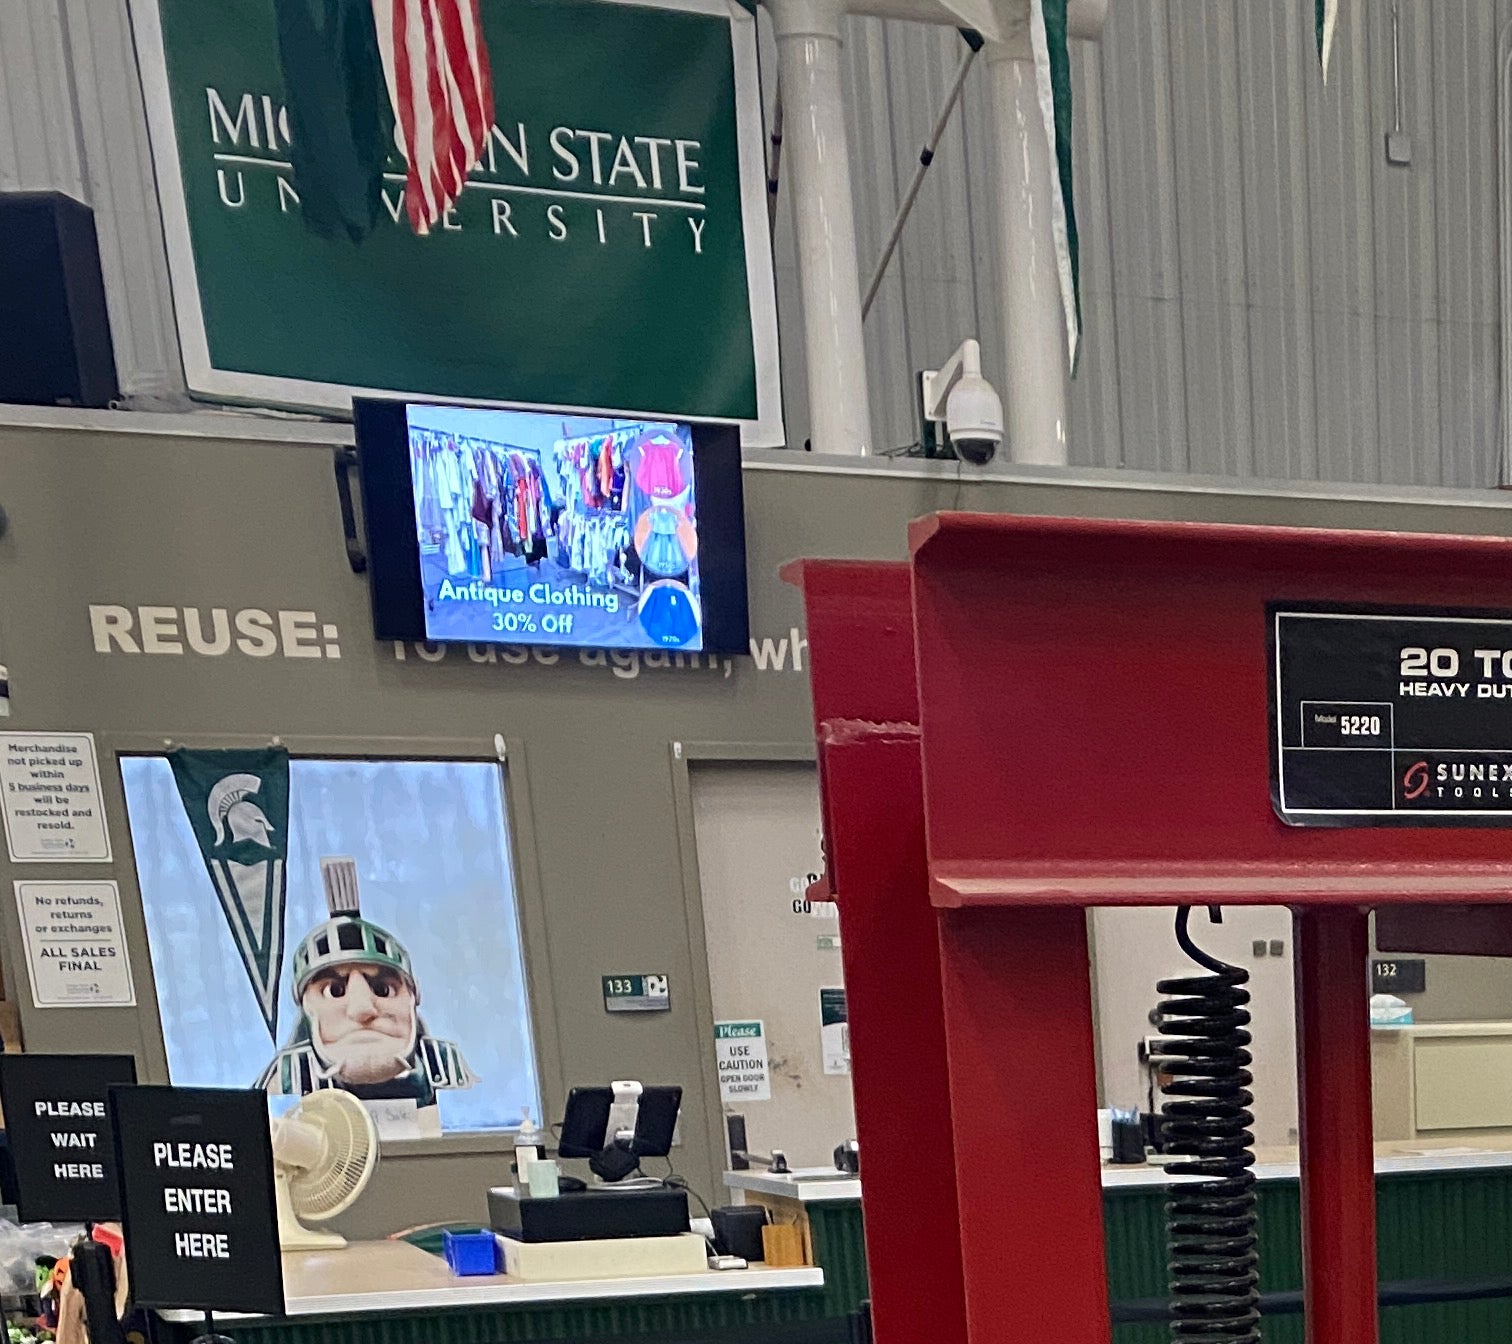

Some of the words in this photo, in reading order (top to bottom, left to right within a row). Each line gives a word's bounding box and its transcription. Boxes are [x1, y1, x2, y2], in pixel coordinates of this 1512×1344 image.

[550, 126, 705, 193] STATE
[217, 169, 705, 254] UNVERSITY
[439, 579, 524, 607] Antique
[529, 583, 619, 612] Clothing
[492, 612, 537, 632] 30%
[542, 613, 574, 634] Off
[88, 603, 342, 659] REUSE:
[1400, 647, 1459, 678] 20
[1400, 682, 1470, 697] HEAVY
[1341, 715, 1381, 735] 5220
[8, 744, 77, 753] Merchandise
[7, 757, 26, 766] not
[29, 757, 66, 767] picked
[69, 758, 83, 767] up
[30, 770, 64, 779] within
[9, 782, 15, 792] 5
[18, 782, 63, 792] business
[65, 783, 90, 793] days
[33, 795, 52, 804] will
[55, 796, 69, 804] be
[15, 808, 69, 817] restocked
[72, 808, 92, 817] and
[37, 821, 75, 830] resold.
[35, 896, 52, 905] No
[55, 896, 104, 907] refunds,
[50, 910, 93, 919] returns
[35, 924, 48, 933] or
[51, 923, 113, 935] exchanges
[40, 947, 67, 958] ALL
[71, 947, 116, 958] SALES
[59, 961, 102, 971] FINAL
[1376, 963, 1397, 976] 132
[607, 980, 633, 993] 133
[719, 1024, 757, 1038] Please
[729, 1045, 750, 1056] USE
[719, 1059, 763, 1070] CAUTION
[720, 1075, 741, 1083] OPEN
[742, 1073, 765, 1082] DOOR
[728, 1083, 759, 1093] SLOWLY
[34, 1101, 106, 1117] PLEASE
[50, 1132, 97, 1148] WAIT
[153, 1142, 234, 1169] PLEASE
[54, 1163, 104, 1179] HERE
[164, 1187, 232, 1214] ENTER
[175, 1232, 230, 1259] HERE
